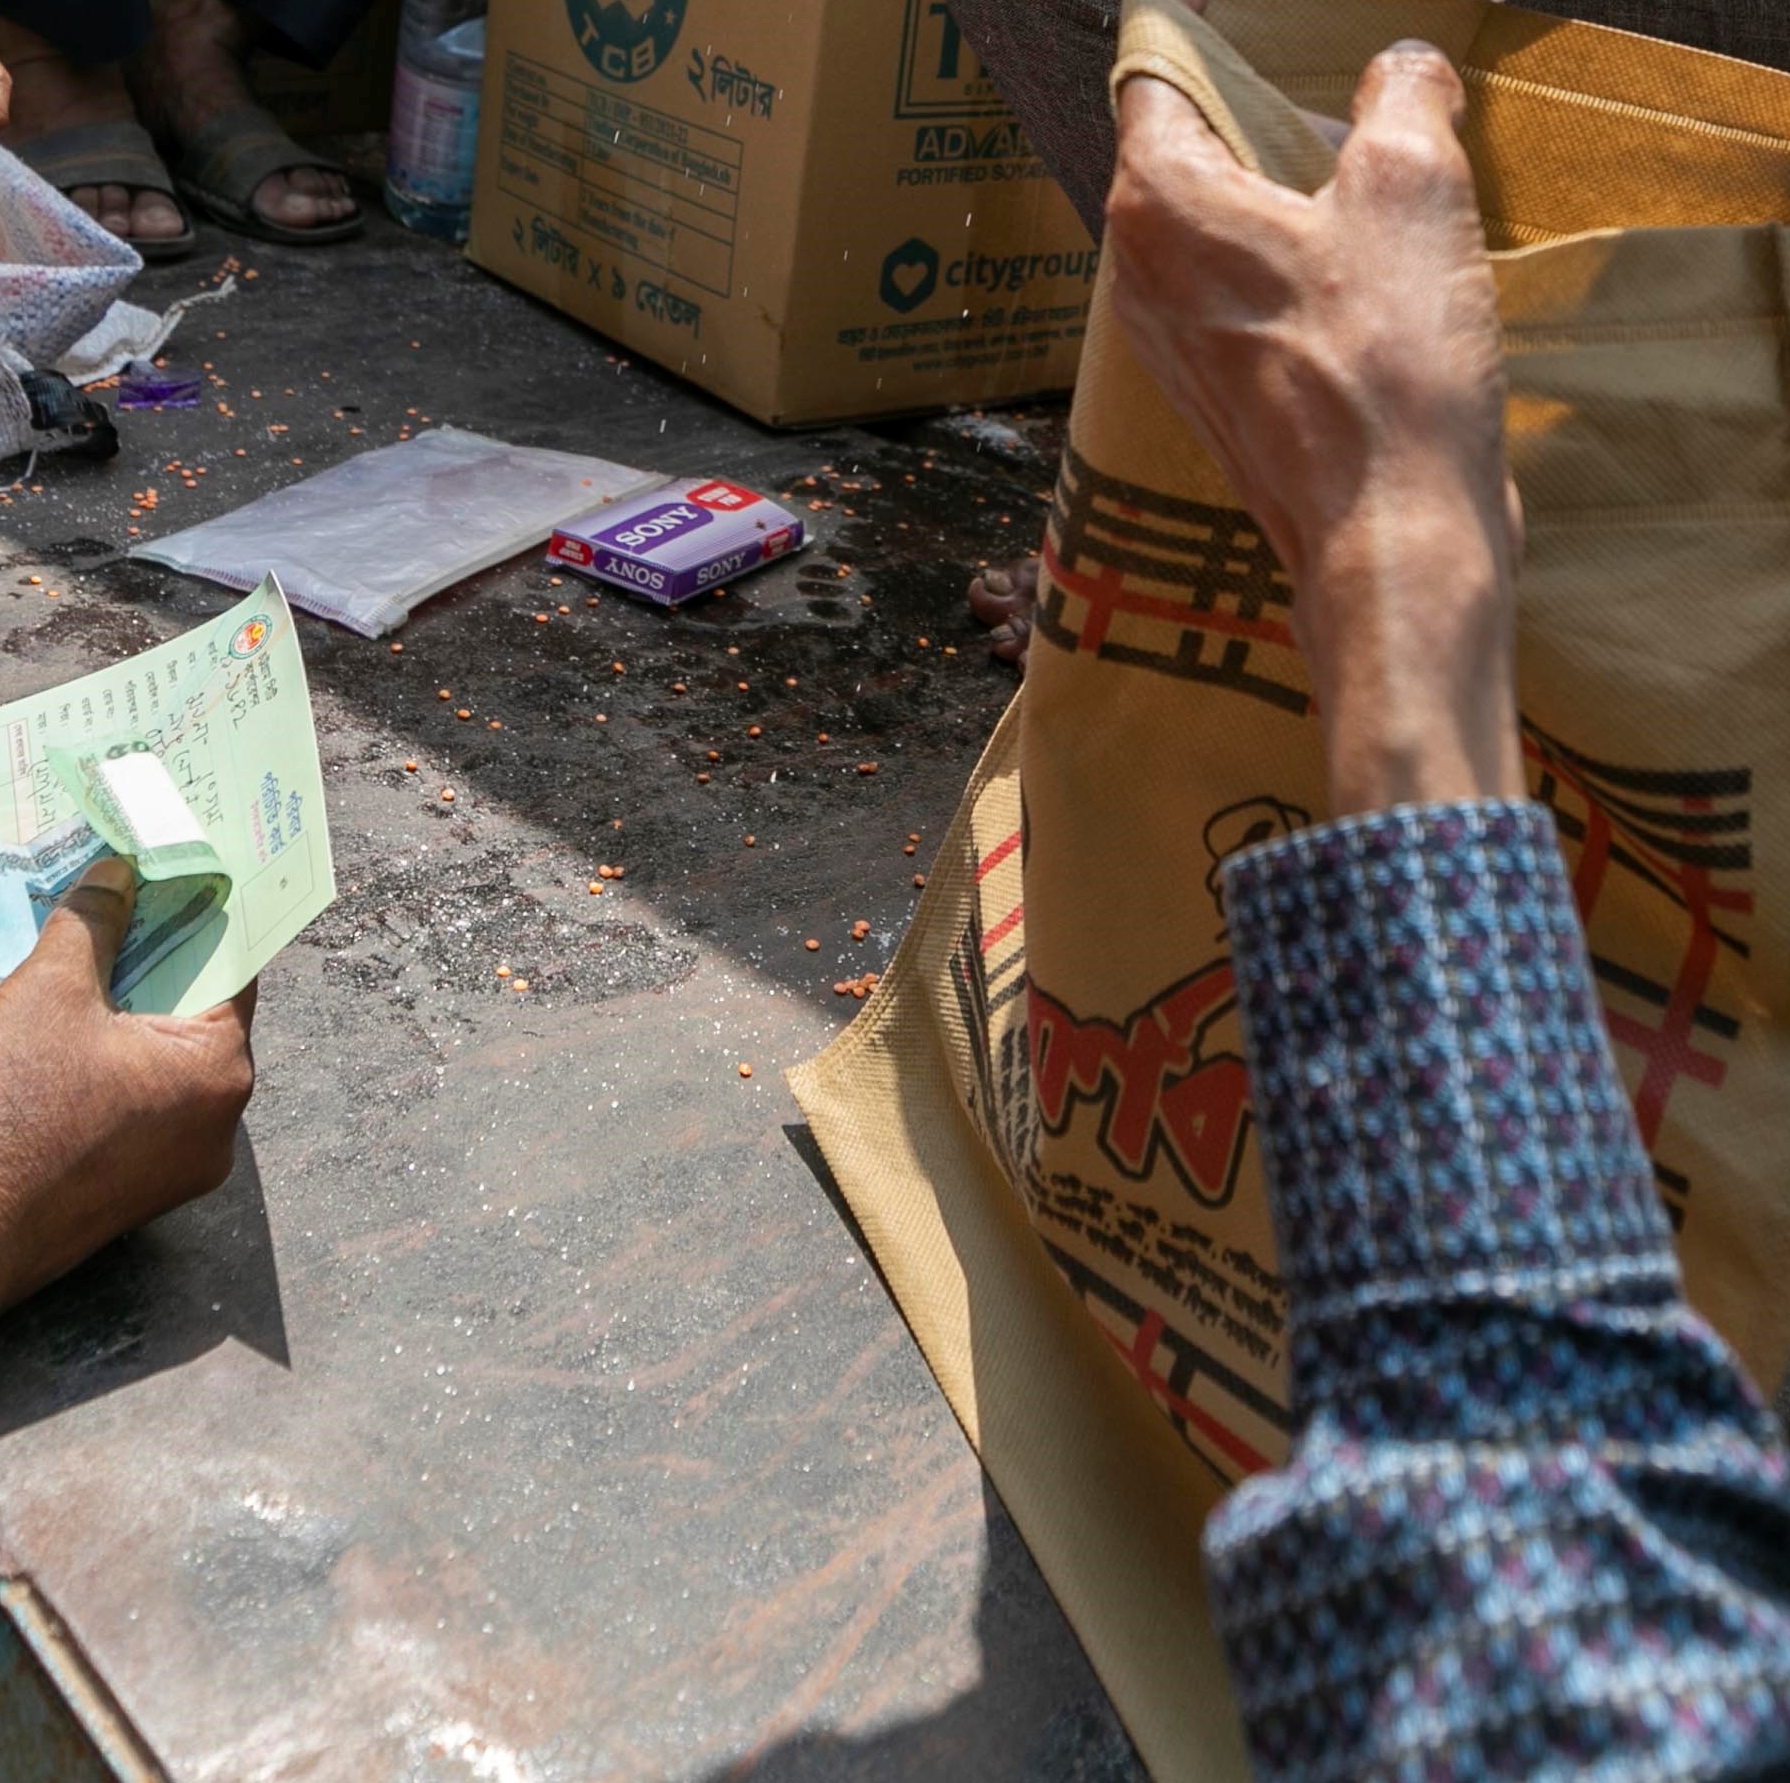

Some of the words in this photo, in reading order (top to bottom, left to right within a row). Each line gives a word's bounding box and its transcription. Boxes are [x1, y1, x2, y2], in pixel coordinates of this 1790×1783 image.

[579, 25, 657, 78] TCB
[710, 54, 777, 120] লিটার
[897, 165, 987, 187] FORTIFIED
[945, 239, 1103, 293] citygroup
[615, 505, 699, 548] SONY
[605, 556, 666, 591] SONY
[696, 552, 747, 586] SONY
[285, 790, 303, 840] পরিবার
[268, 824, 287, 855] কার্ড
